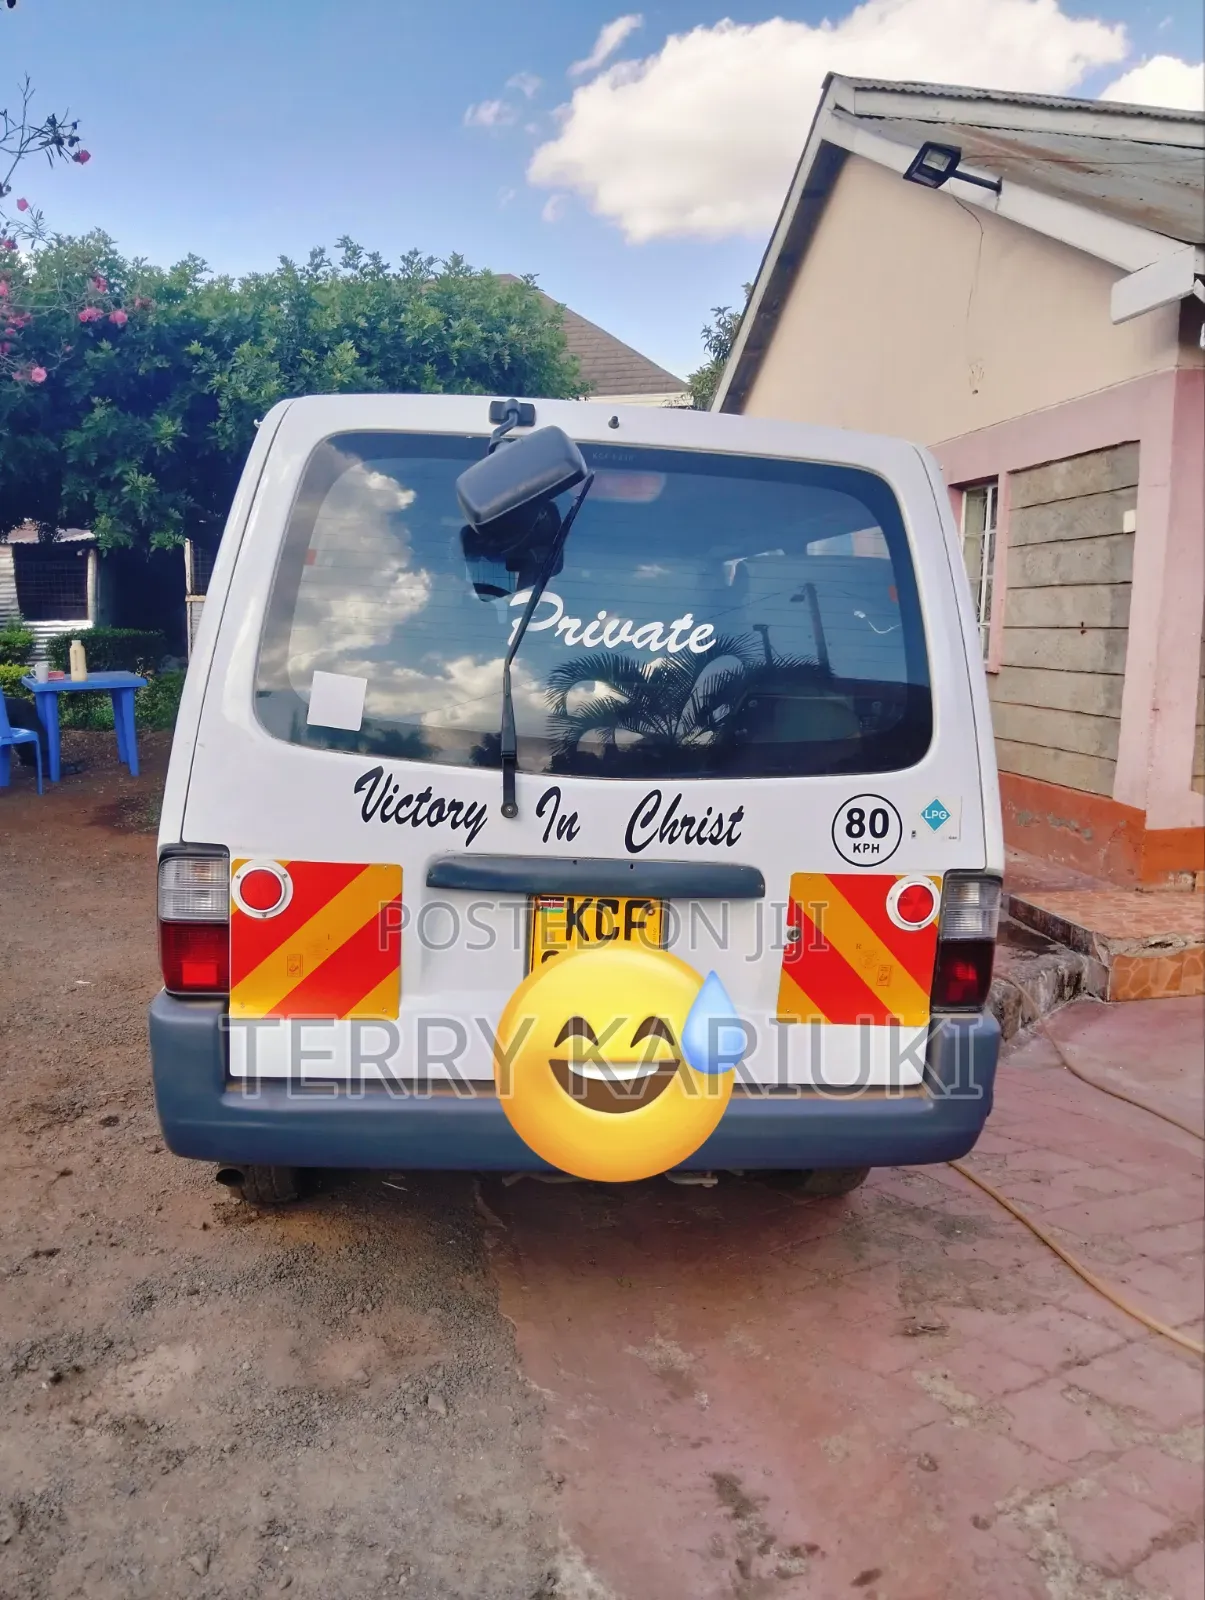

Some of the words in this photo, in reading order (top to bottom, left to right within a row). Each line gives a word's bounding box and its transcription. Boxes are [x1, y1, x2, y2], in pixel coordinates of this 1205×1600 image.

[507, 590, 717, 654] Private
[353, 765, 488, 847] Victory
[535, 785, 581, 845] In
[624, 788, 745, 854] Christ
[844, 806, 890, 840] 80
[924, 809, 948, 820] LPG
[852, 842, 881, 854] KPH
[565, 897, 651, 941] KCF
